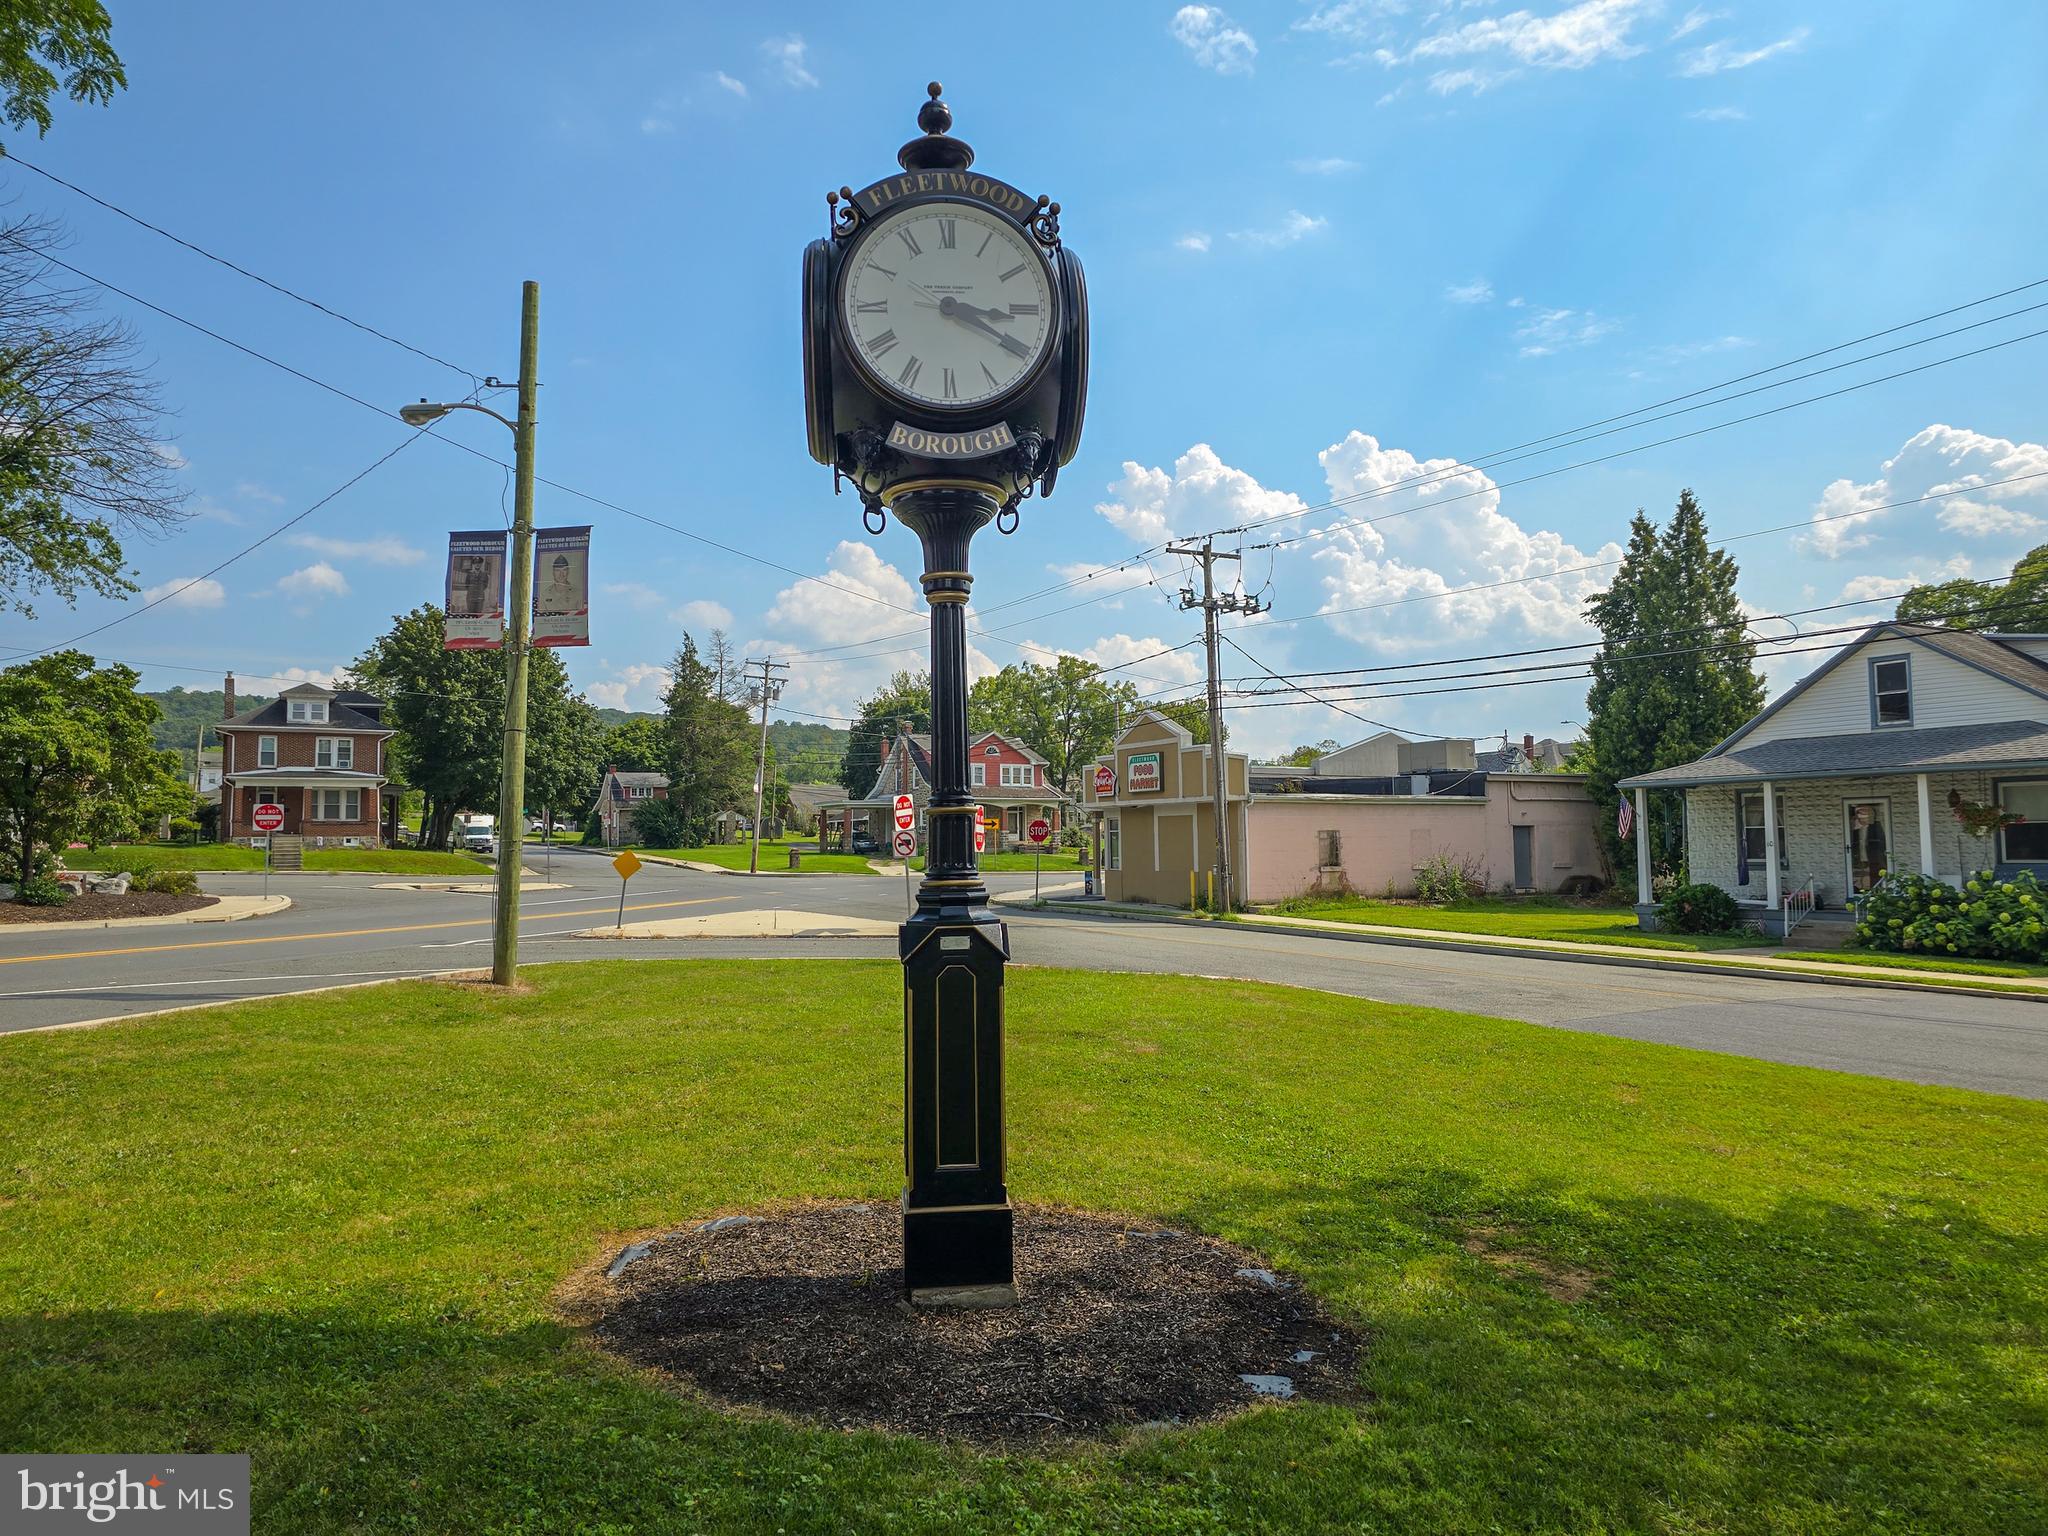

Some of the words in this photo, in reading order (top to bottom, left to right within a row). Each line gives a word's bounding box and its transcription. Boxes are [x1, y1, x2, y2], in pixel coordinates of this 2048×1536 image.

[868, 172, 1024, 212] FLEETWOOD
[896, 226, 923, 260] XI
[937, 219, 957, 250] XII
[975, 231, 993, 258] I
[866, 257, 898, 282] X
[999, 262, 1027, 283] II
[1008, 303, 1040, 316] III
[978, 360, 1001, 390] V
[891, 426, 1010, 455] BOROUGH
[1134, 763, 1154, 776] FOOD
[1130, 776, 1159, 790] MARKET
[1029, 826, 1048, 836] STOP
